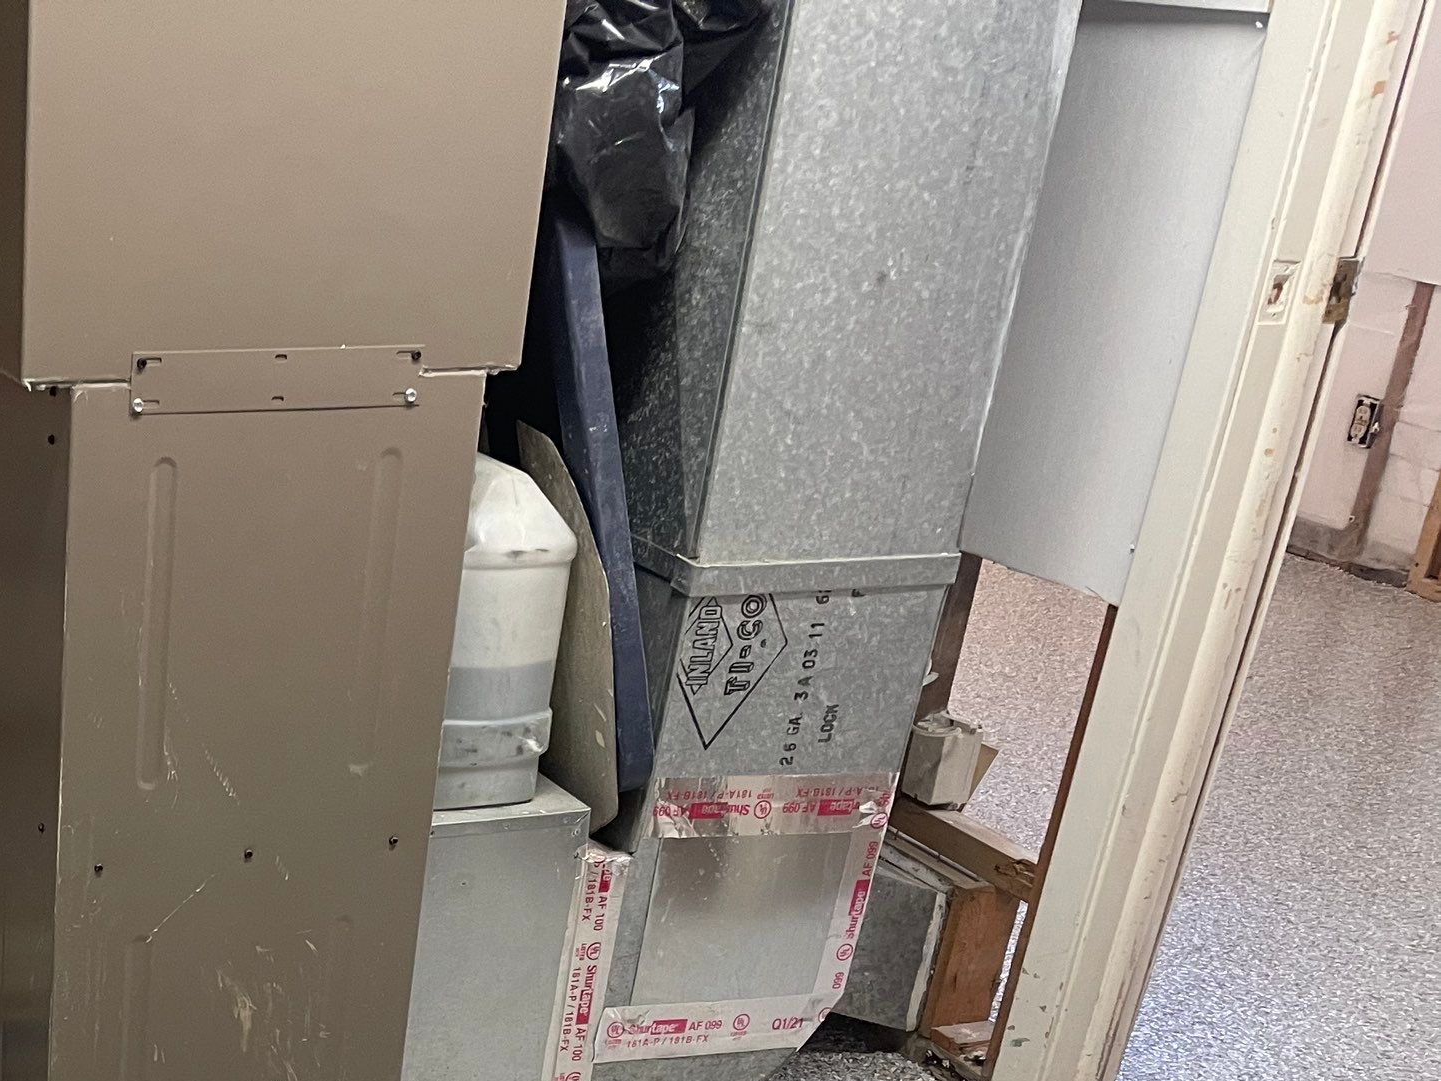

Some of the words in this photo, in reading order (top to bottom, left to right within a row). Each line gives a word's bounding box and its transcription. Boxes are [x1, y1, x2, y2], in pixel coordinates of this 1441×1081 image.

[685, 604, 723, 687] INLAND
[723, 593, 768, 696] TI-CO
[598, 896, 608, 910] AF
[593, 913, 605, 932] 100
[579, 964, 598, 1017] Shurtape
[688, 1021, 704, 1031] AF
[772, 1016, 804, 1031] Q1/21
[575, 1027, 587, 1042] AF
[571, 1044, 584, 1062] 100
